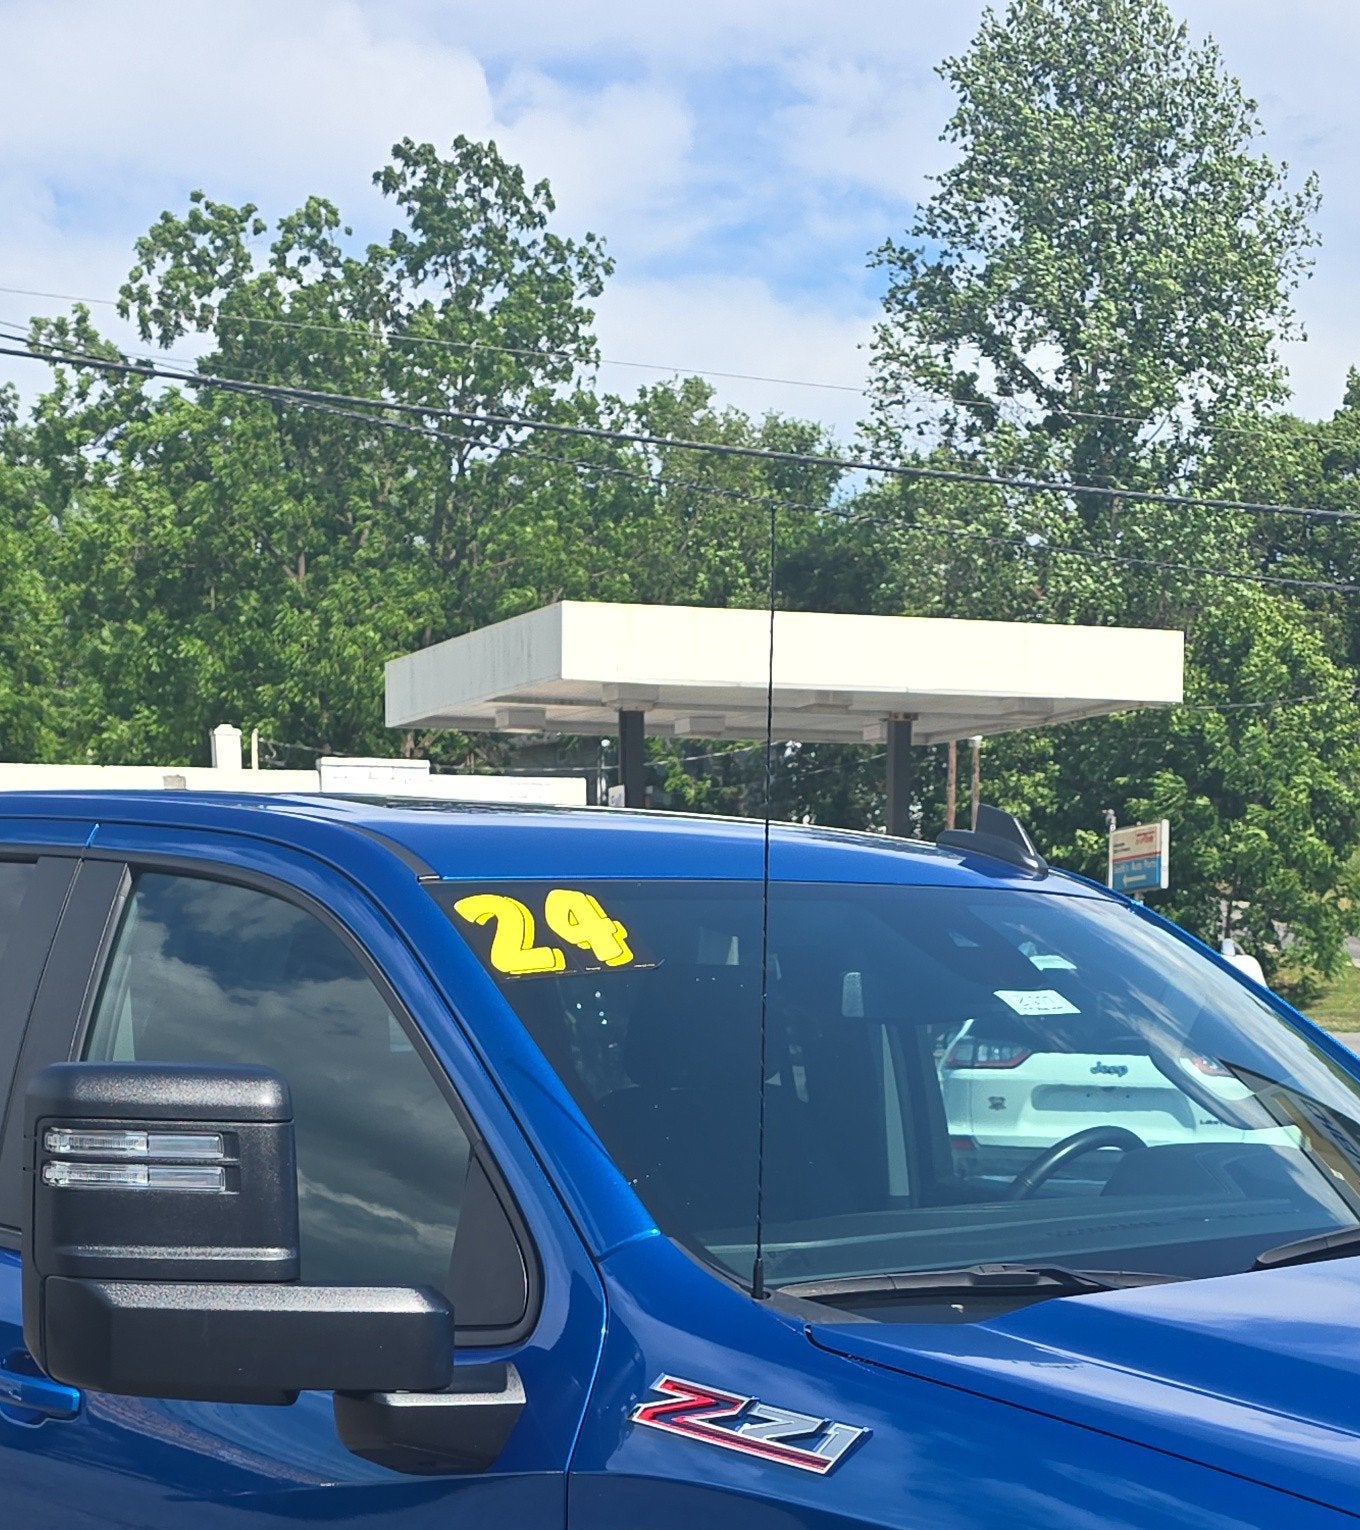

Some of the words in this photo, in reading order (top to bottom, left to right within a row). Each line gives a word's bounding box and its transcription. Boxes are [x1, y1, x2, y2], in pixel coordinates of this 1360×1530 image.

[454, 889, 634, 974] 24
[1090, 1061, 1128, 1078] Jeep
[627, 1373, 872, 1476] Z71
